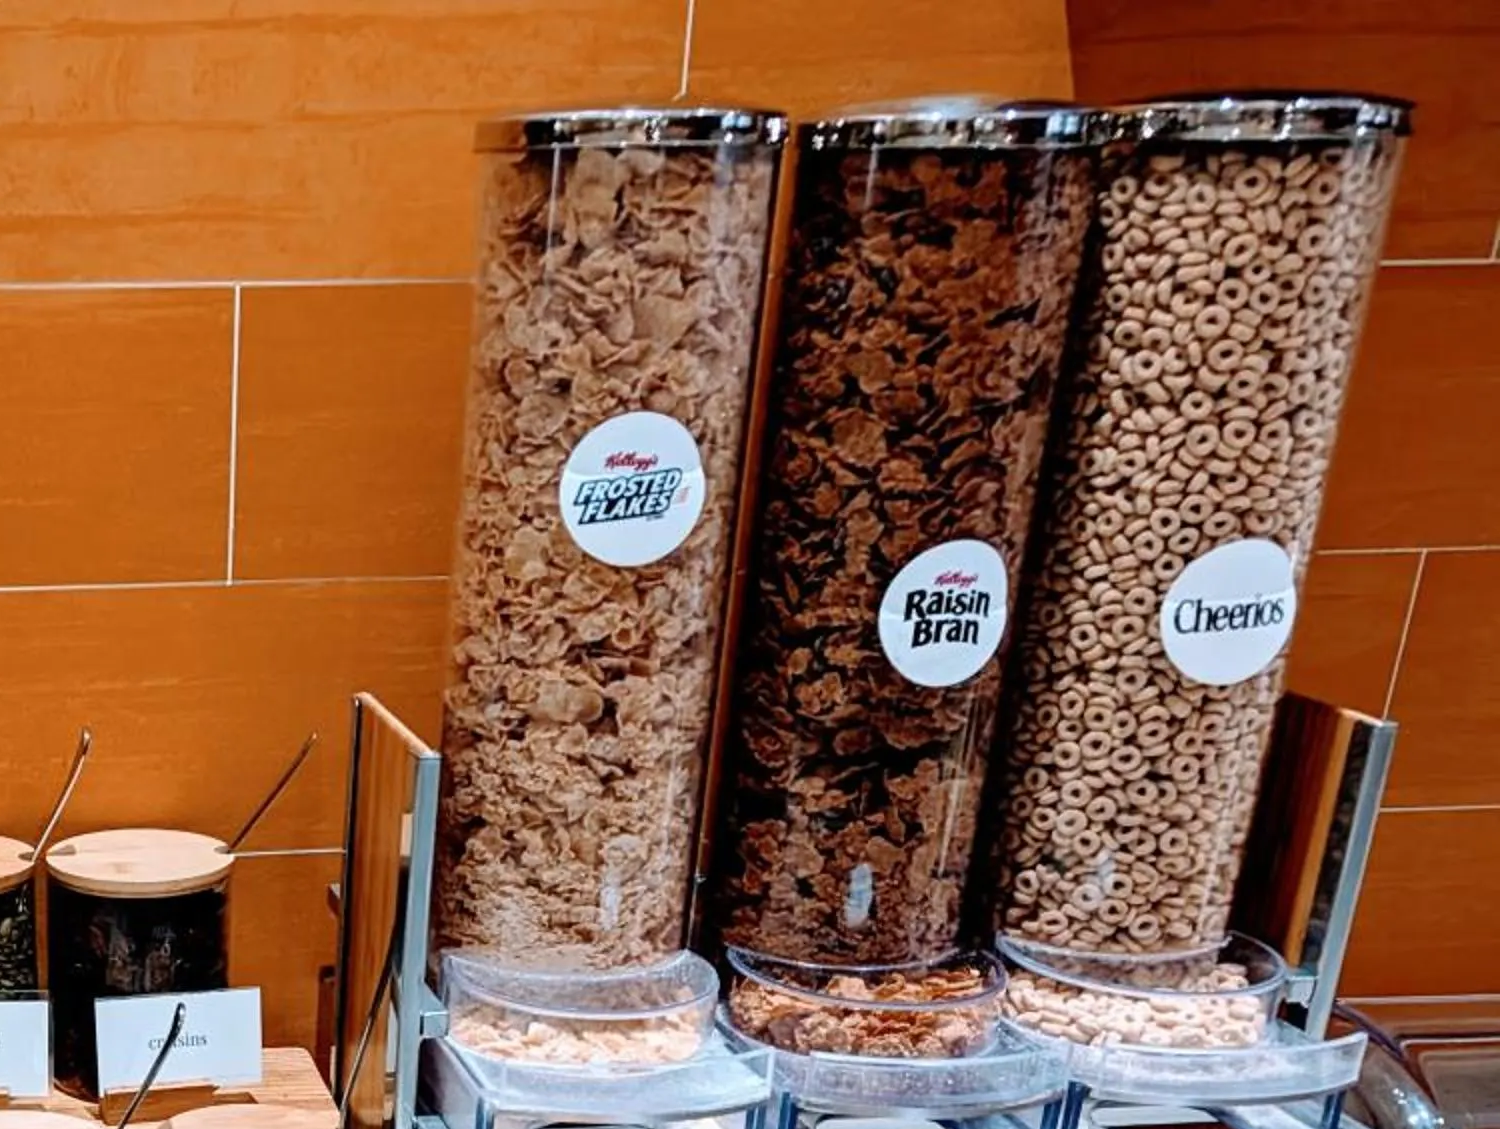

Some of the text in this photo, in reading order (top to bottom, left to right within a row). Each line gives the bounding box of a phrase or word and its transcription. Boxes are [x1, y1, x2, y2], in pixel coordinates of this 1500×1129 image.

[575, 469, 682, 504] FROSTED
[580, 491, 670, 524] FLAKES
[904, 589, 990, 621] Raisin
[1174, 595, 1284, 634] Cheerios
[912, 618, 979, 648] Bran
